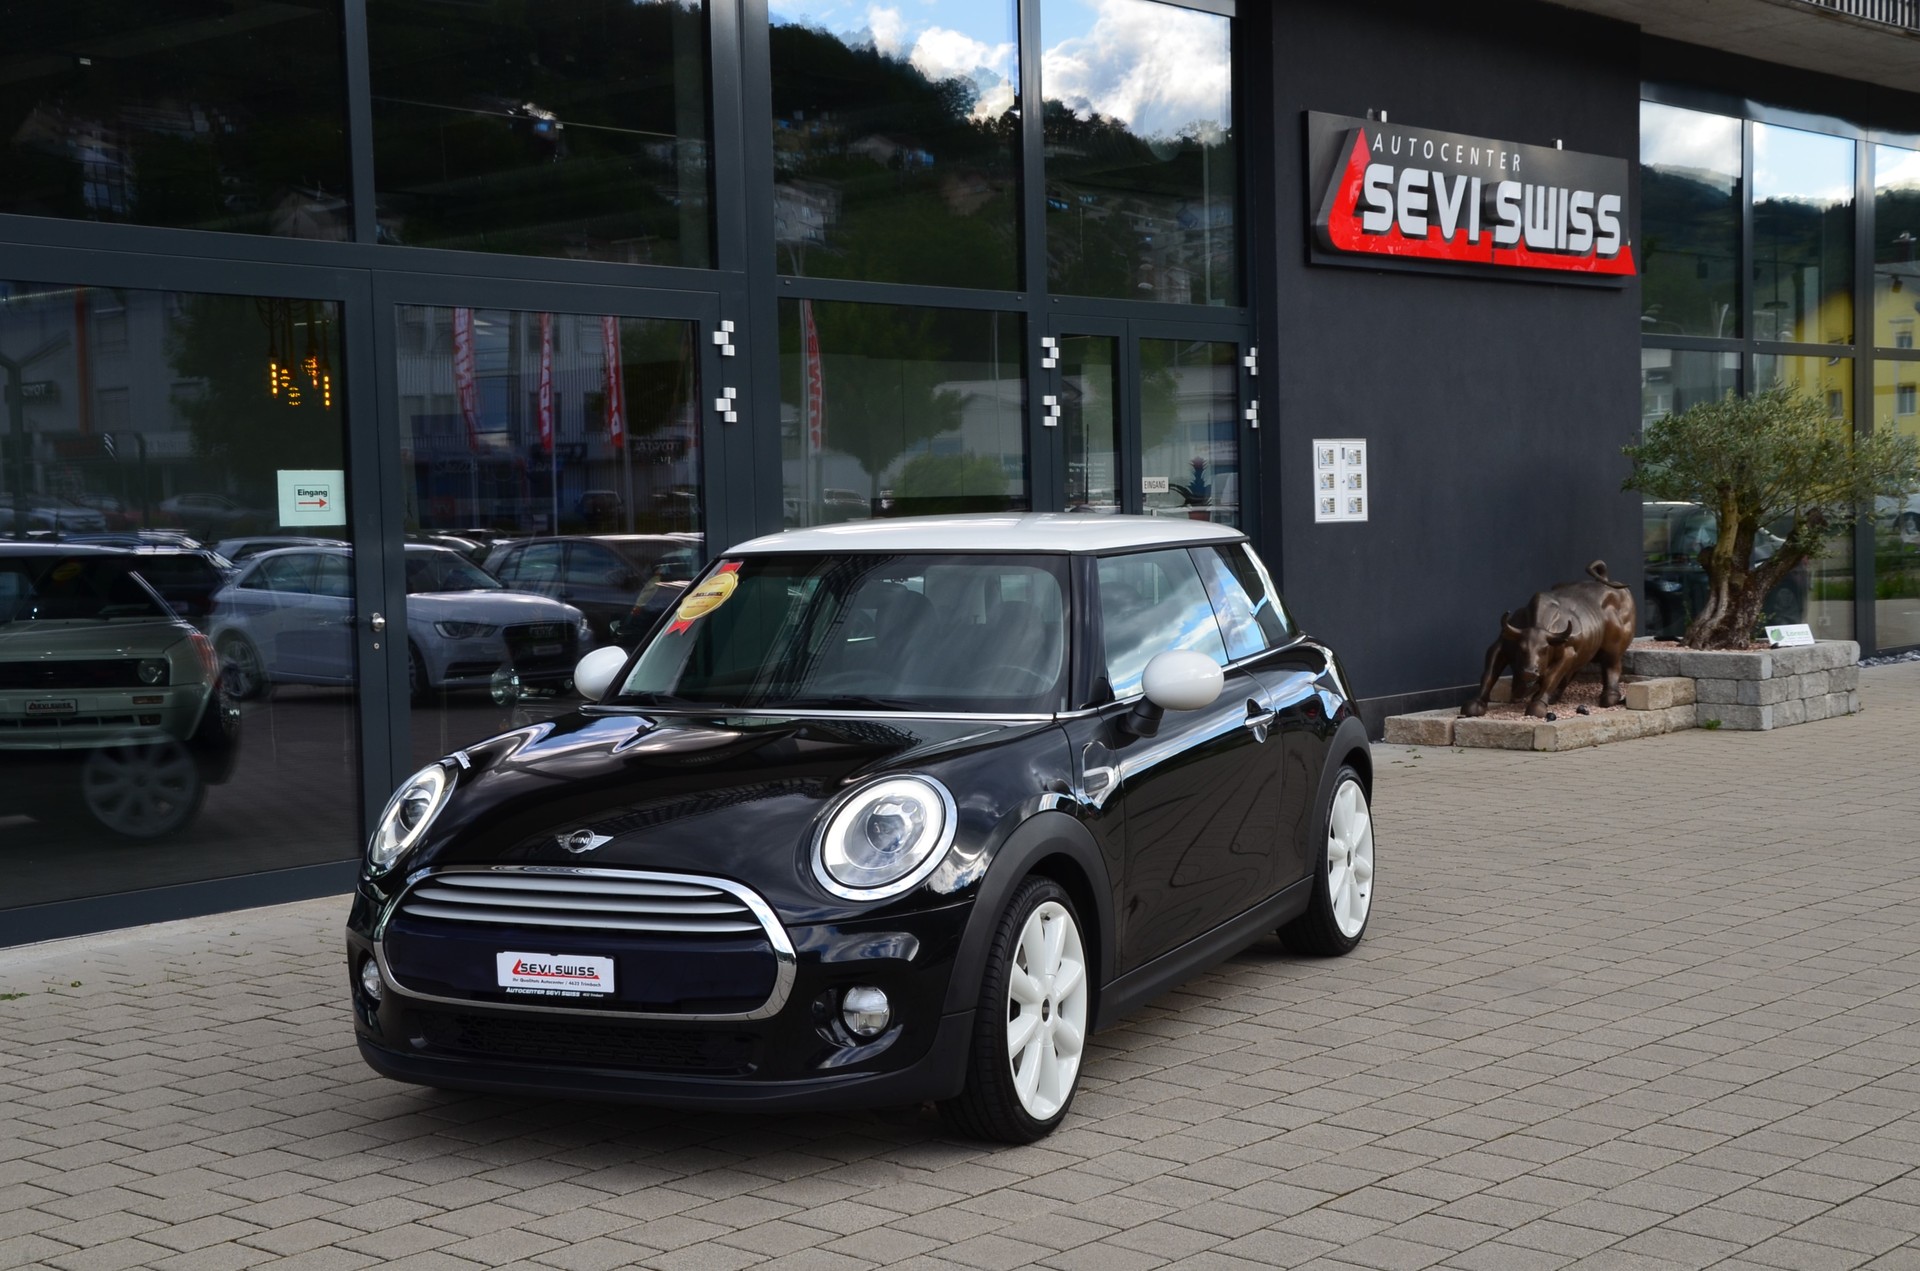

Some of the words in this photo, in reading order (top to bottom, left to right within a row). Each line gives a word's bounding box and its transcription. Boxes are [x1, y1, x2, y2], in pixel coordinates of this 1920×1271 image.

[1372, 132, 1521, 172] AUTOCENTER
[1362, 163, 1480, 242] SEVI
[1494, 180, 1621, 255] SWISS
[1144, 480, 1166, 490] EINGANG
[297, 488, 328, 497] Eingang
[570, 836, 590, 844] MINI
[520, 963, 551, 974] SEVI
[555, 965, 595, 976] SWISS
